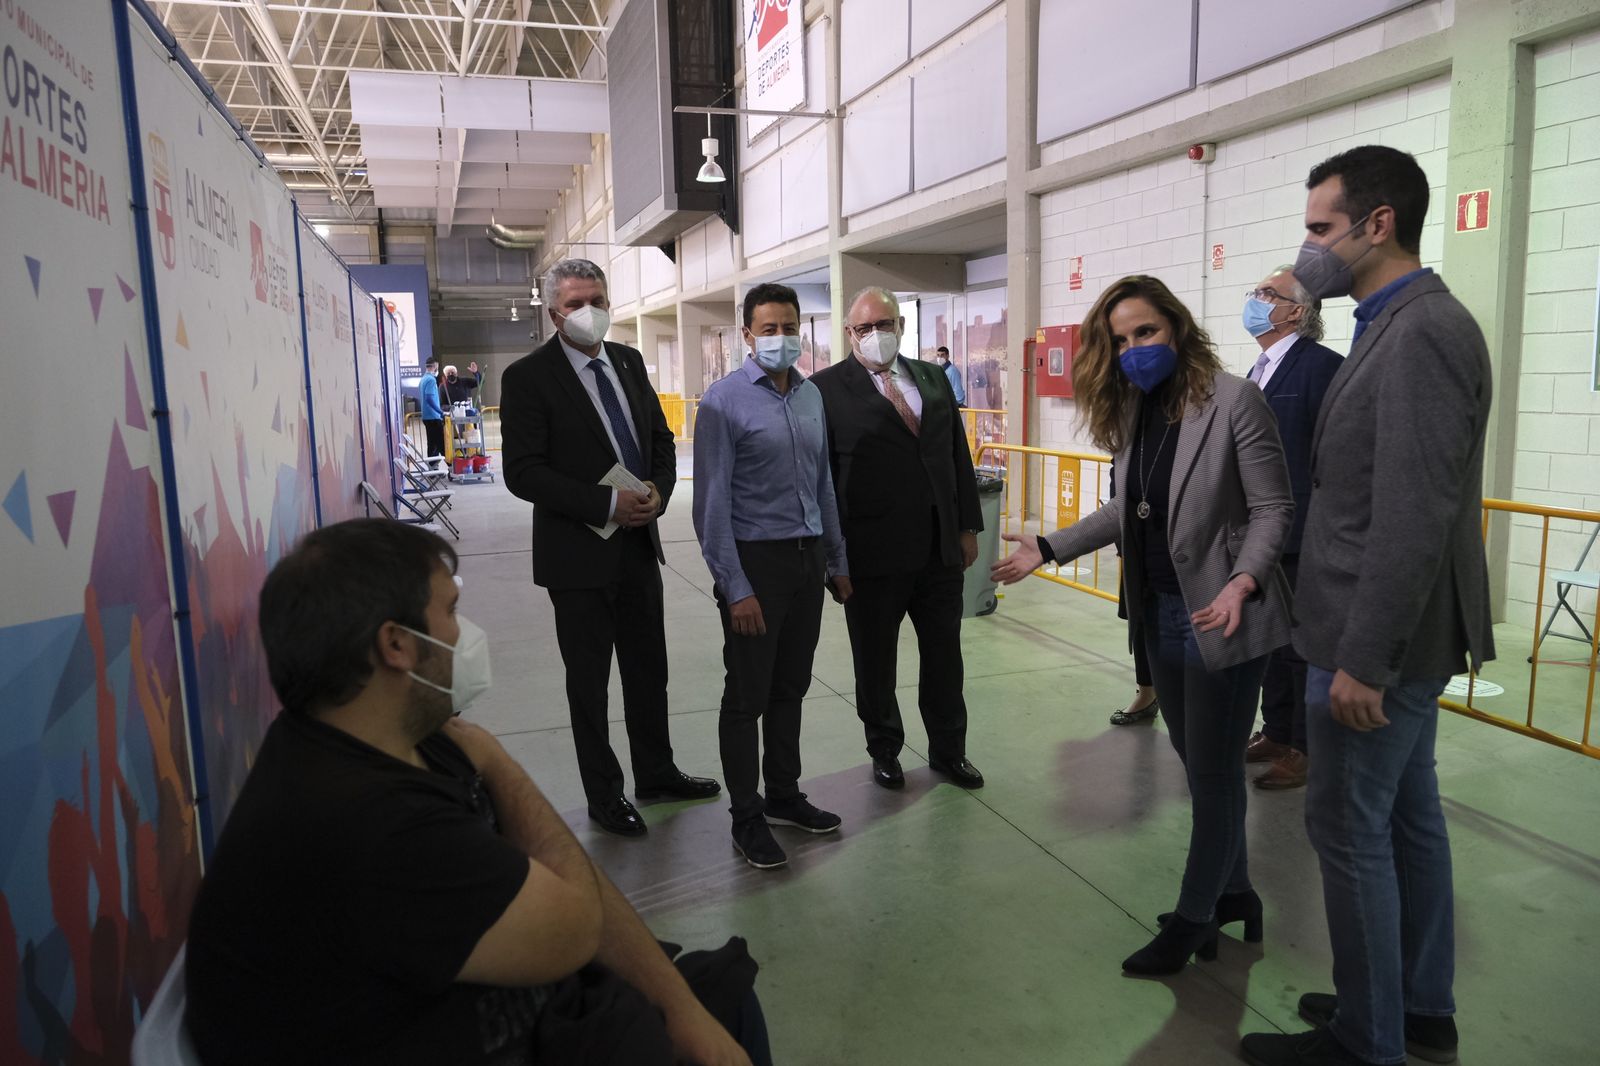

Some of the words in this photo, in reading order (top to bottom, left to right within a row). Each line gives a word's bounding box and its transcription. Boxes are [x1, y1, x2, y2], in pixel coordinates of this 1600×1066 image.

[3, 44, 88, 154] ORTES
[17, 6, 78, 79] MUNICIPAL
[81, 64, 95, 92] DE
[0, 115, 111, 226] ALMERIA
